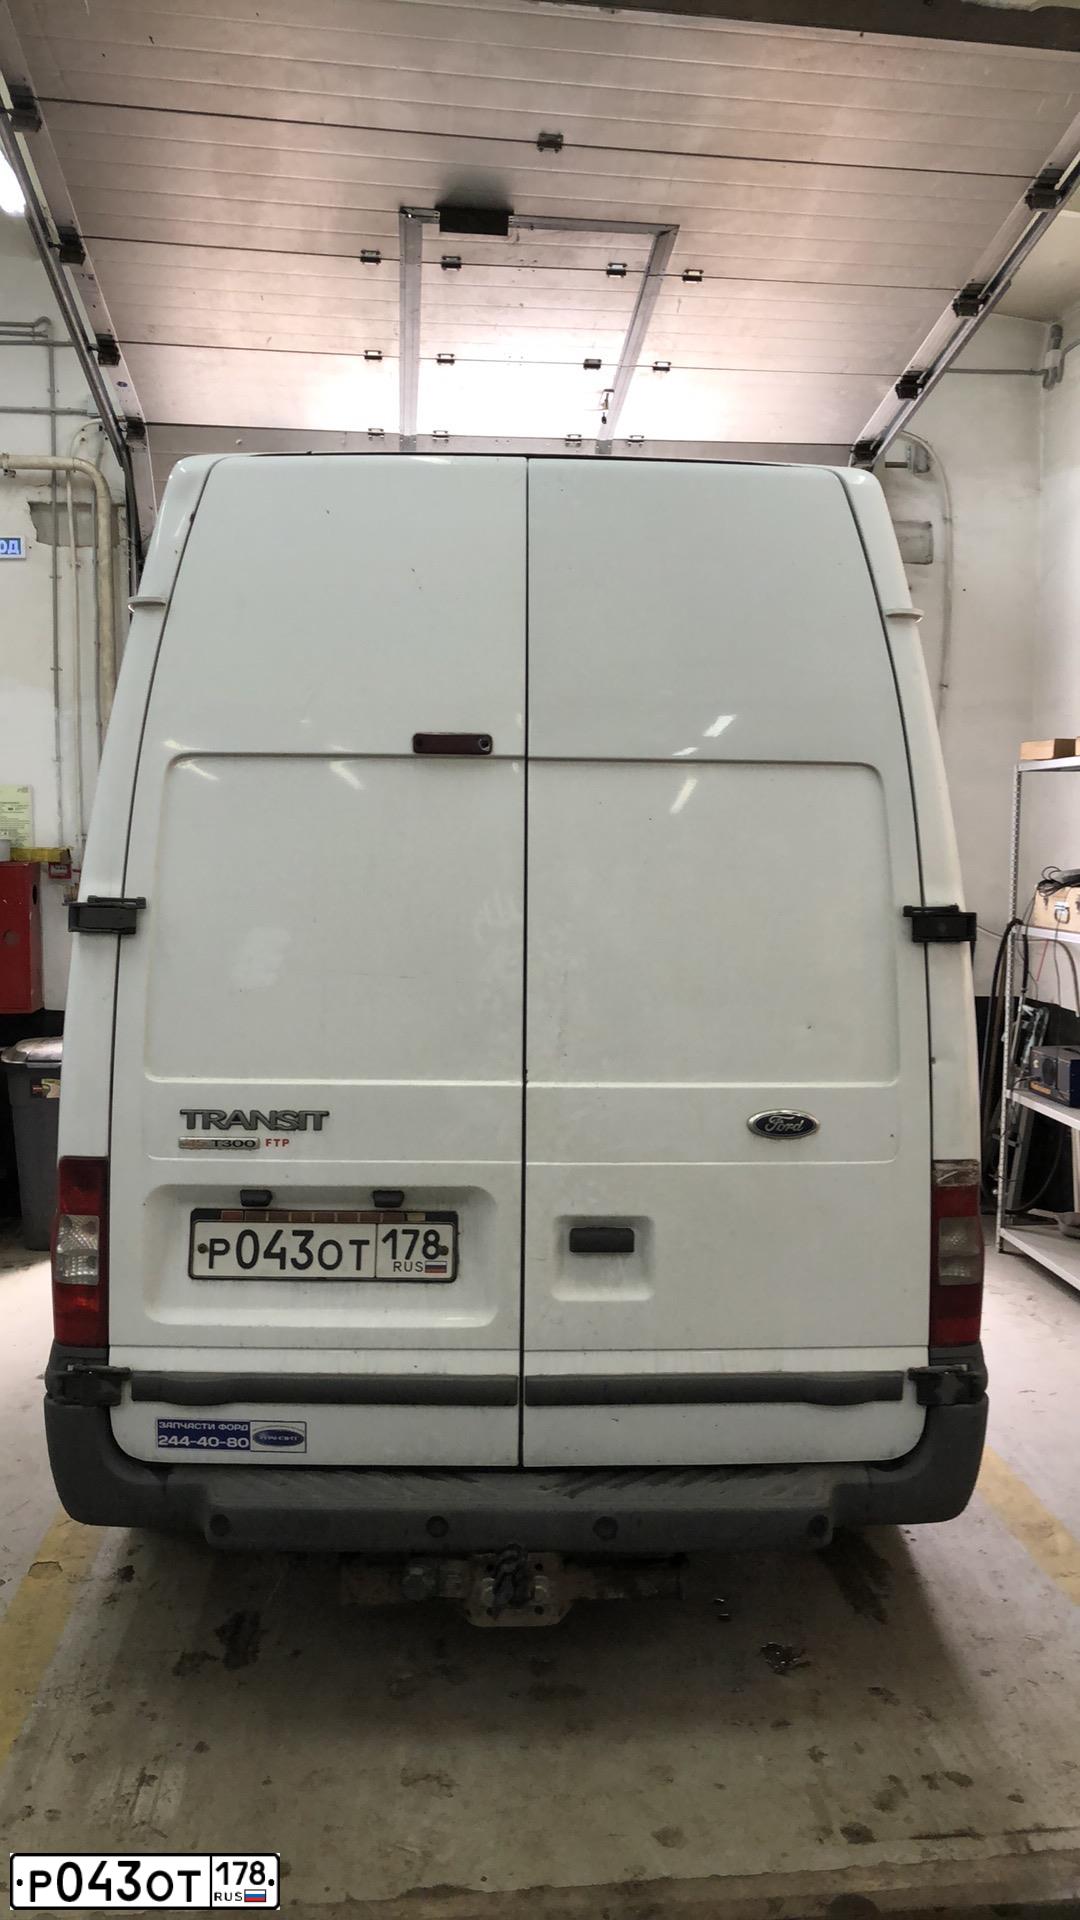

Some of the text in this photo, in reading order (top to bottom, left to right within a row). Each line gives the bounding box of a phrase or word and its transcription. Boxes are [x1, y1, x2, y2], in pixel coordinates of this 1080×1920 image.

[179, 1109, 330, 1131] TRANSIT
[764, 1115, 805, 1132] Ford
[212, 1137, 291, 1149] T300 FTP
[381, 1228, 440, 1260] 178
[393, 1261, 424, 1273] RUS
[158, 1421, 249, 1431] ЗАПЧАСТИ ФОРД
[158, 1434, 250, 1448] 244-40-80
